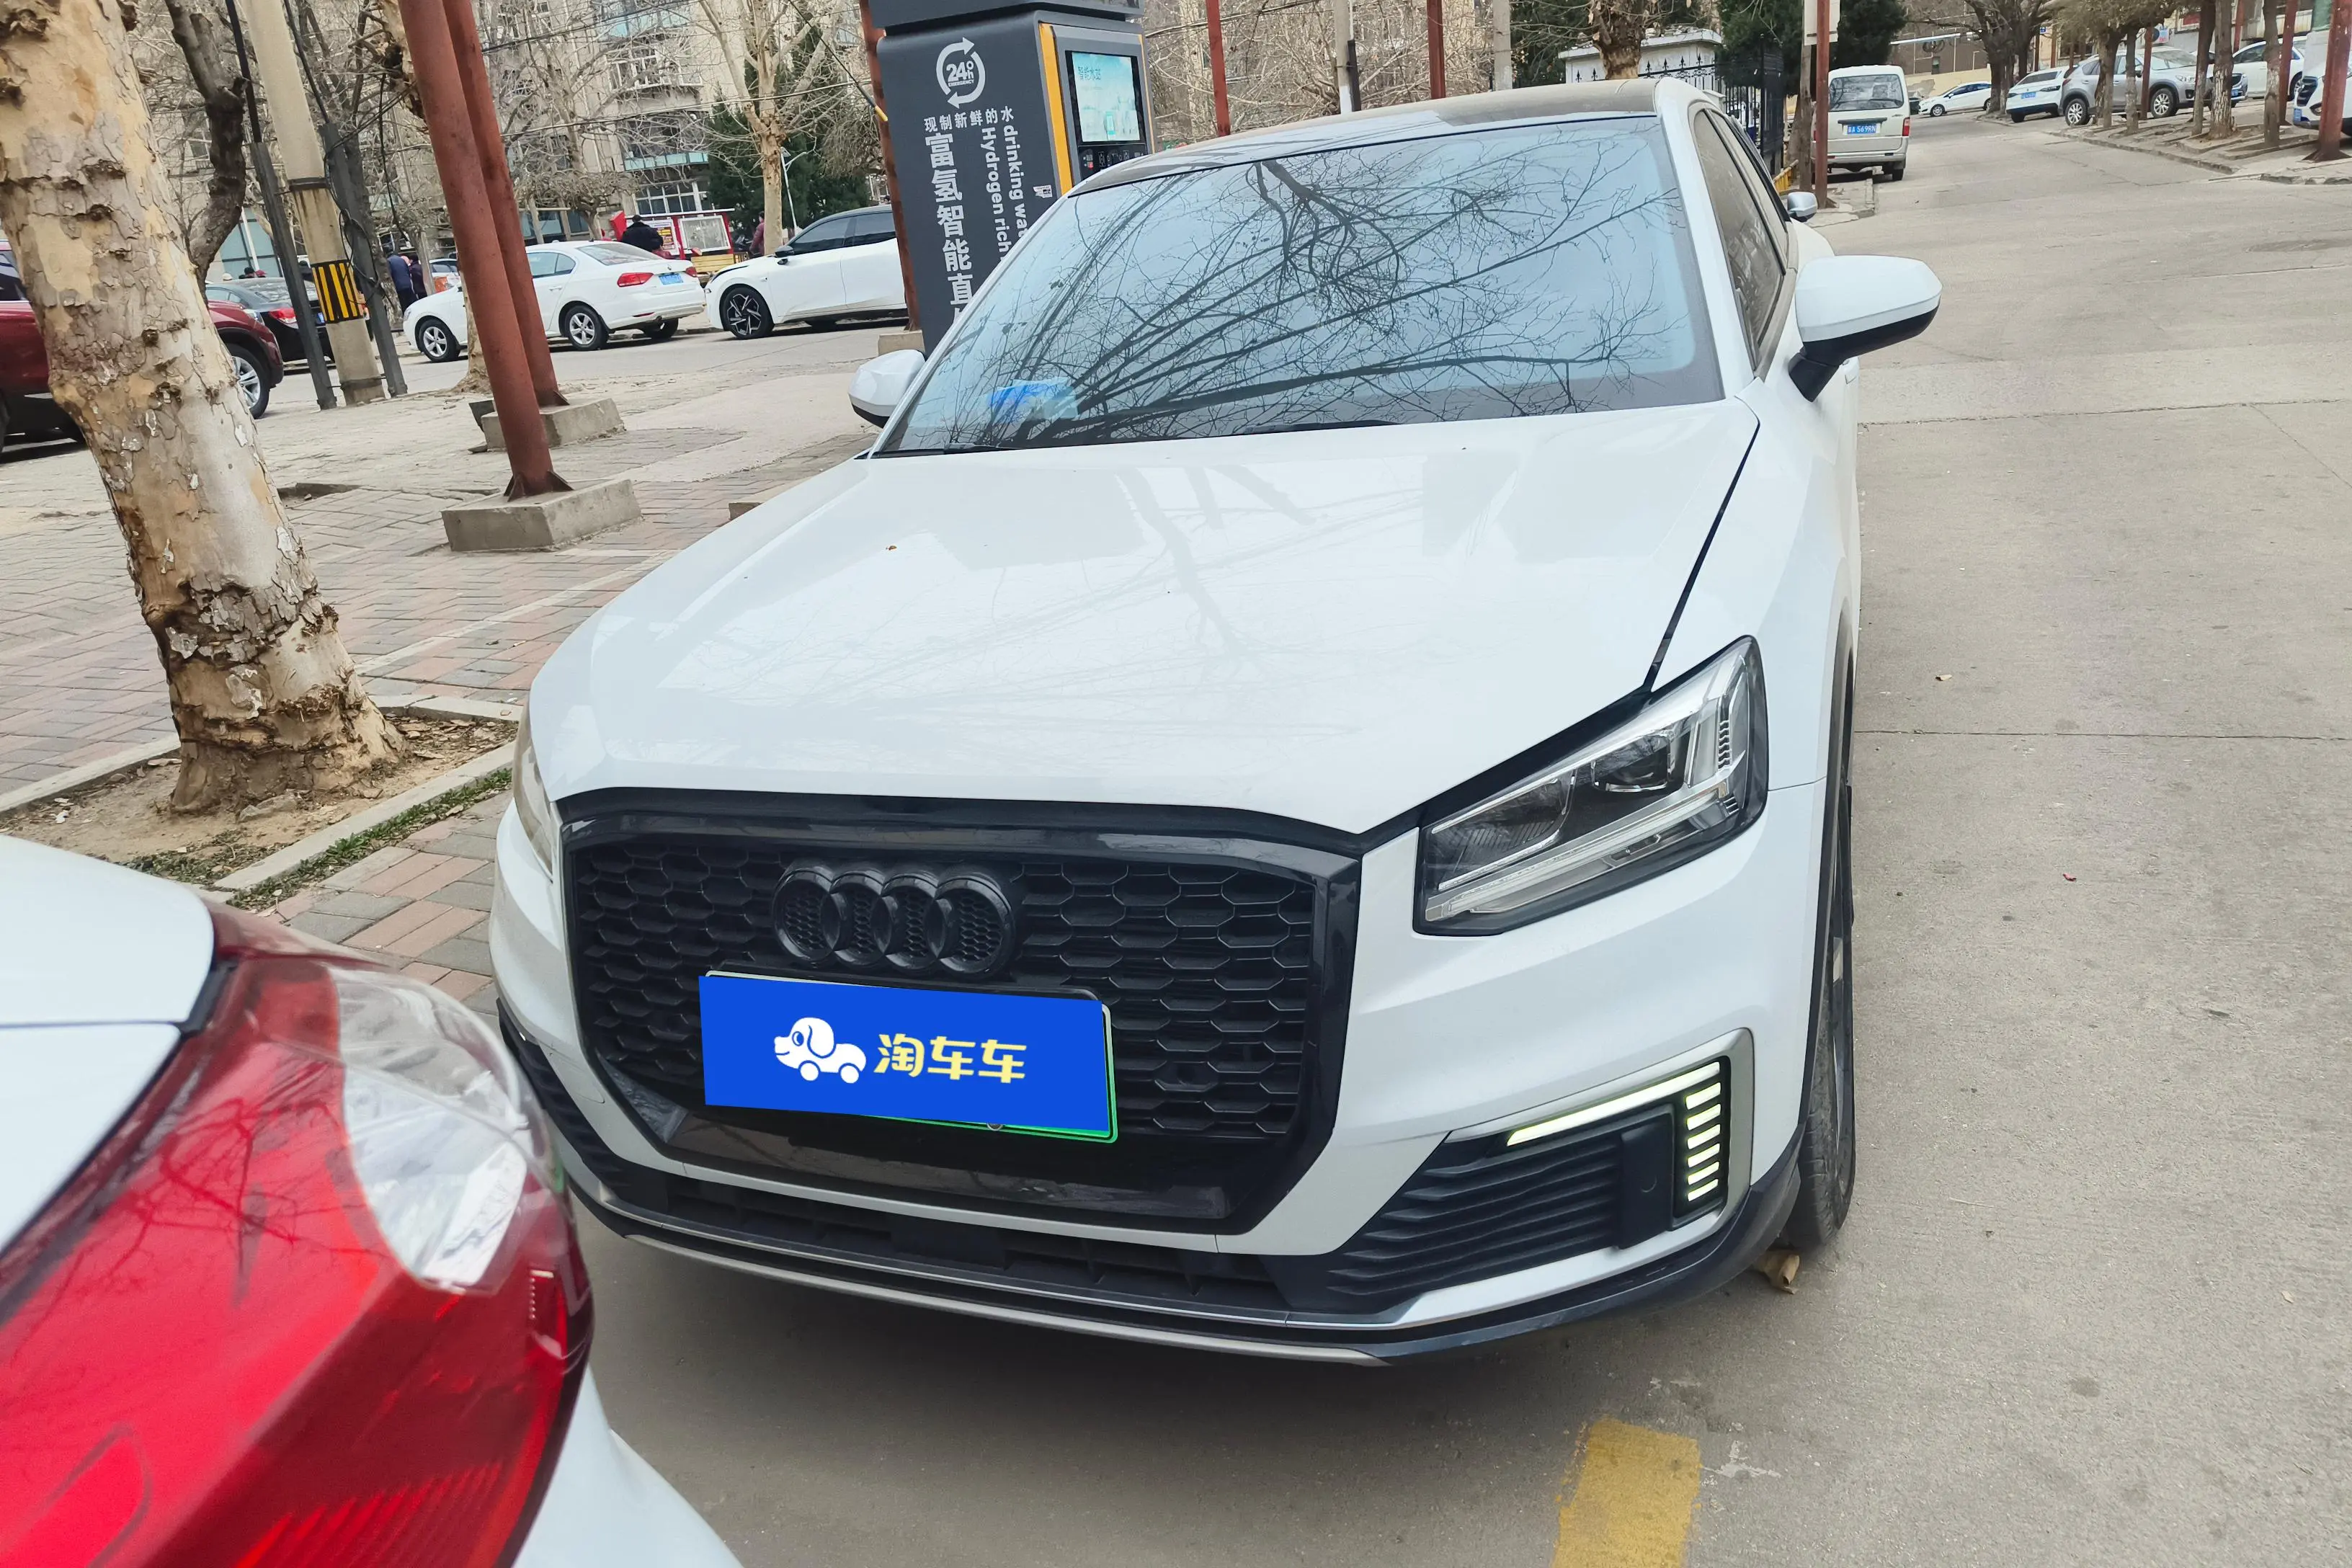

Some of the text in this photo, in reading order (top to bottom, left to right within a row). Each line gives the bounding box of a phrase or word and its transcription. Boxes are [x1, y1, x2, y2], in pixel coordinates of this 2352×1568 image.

[924, 106, 1014, 132] 现制新鲜的水
[1003, 125, 1024, 200] drinking
[925, 133, 974, 322] 富氢智能直
[981, 127, 1012, 252] Hydrogen rich
